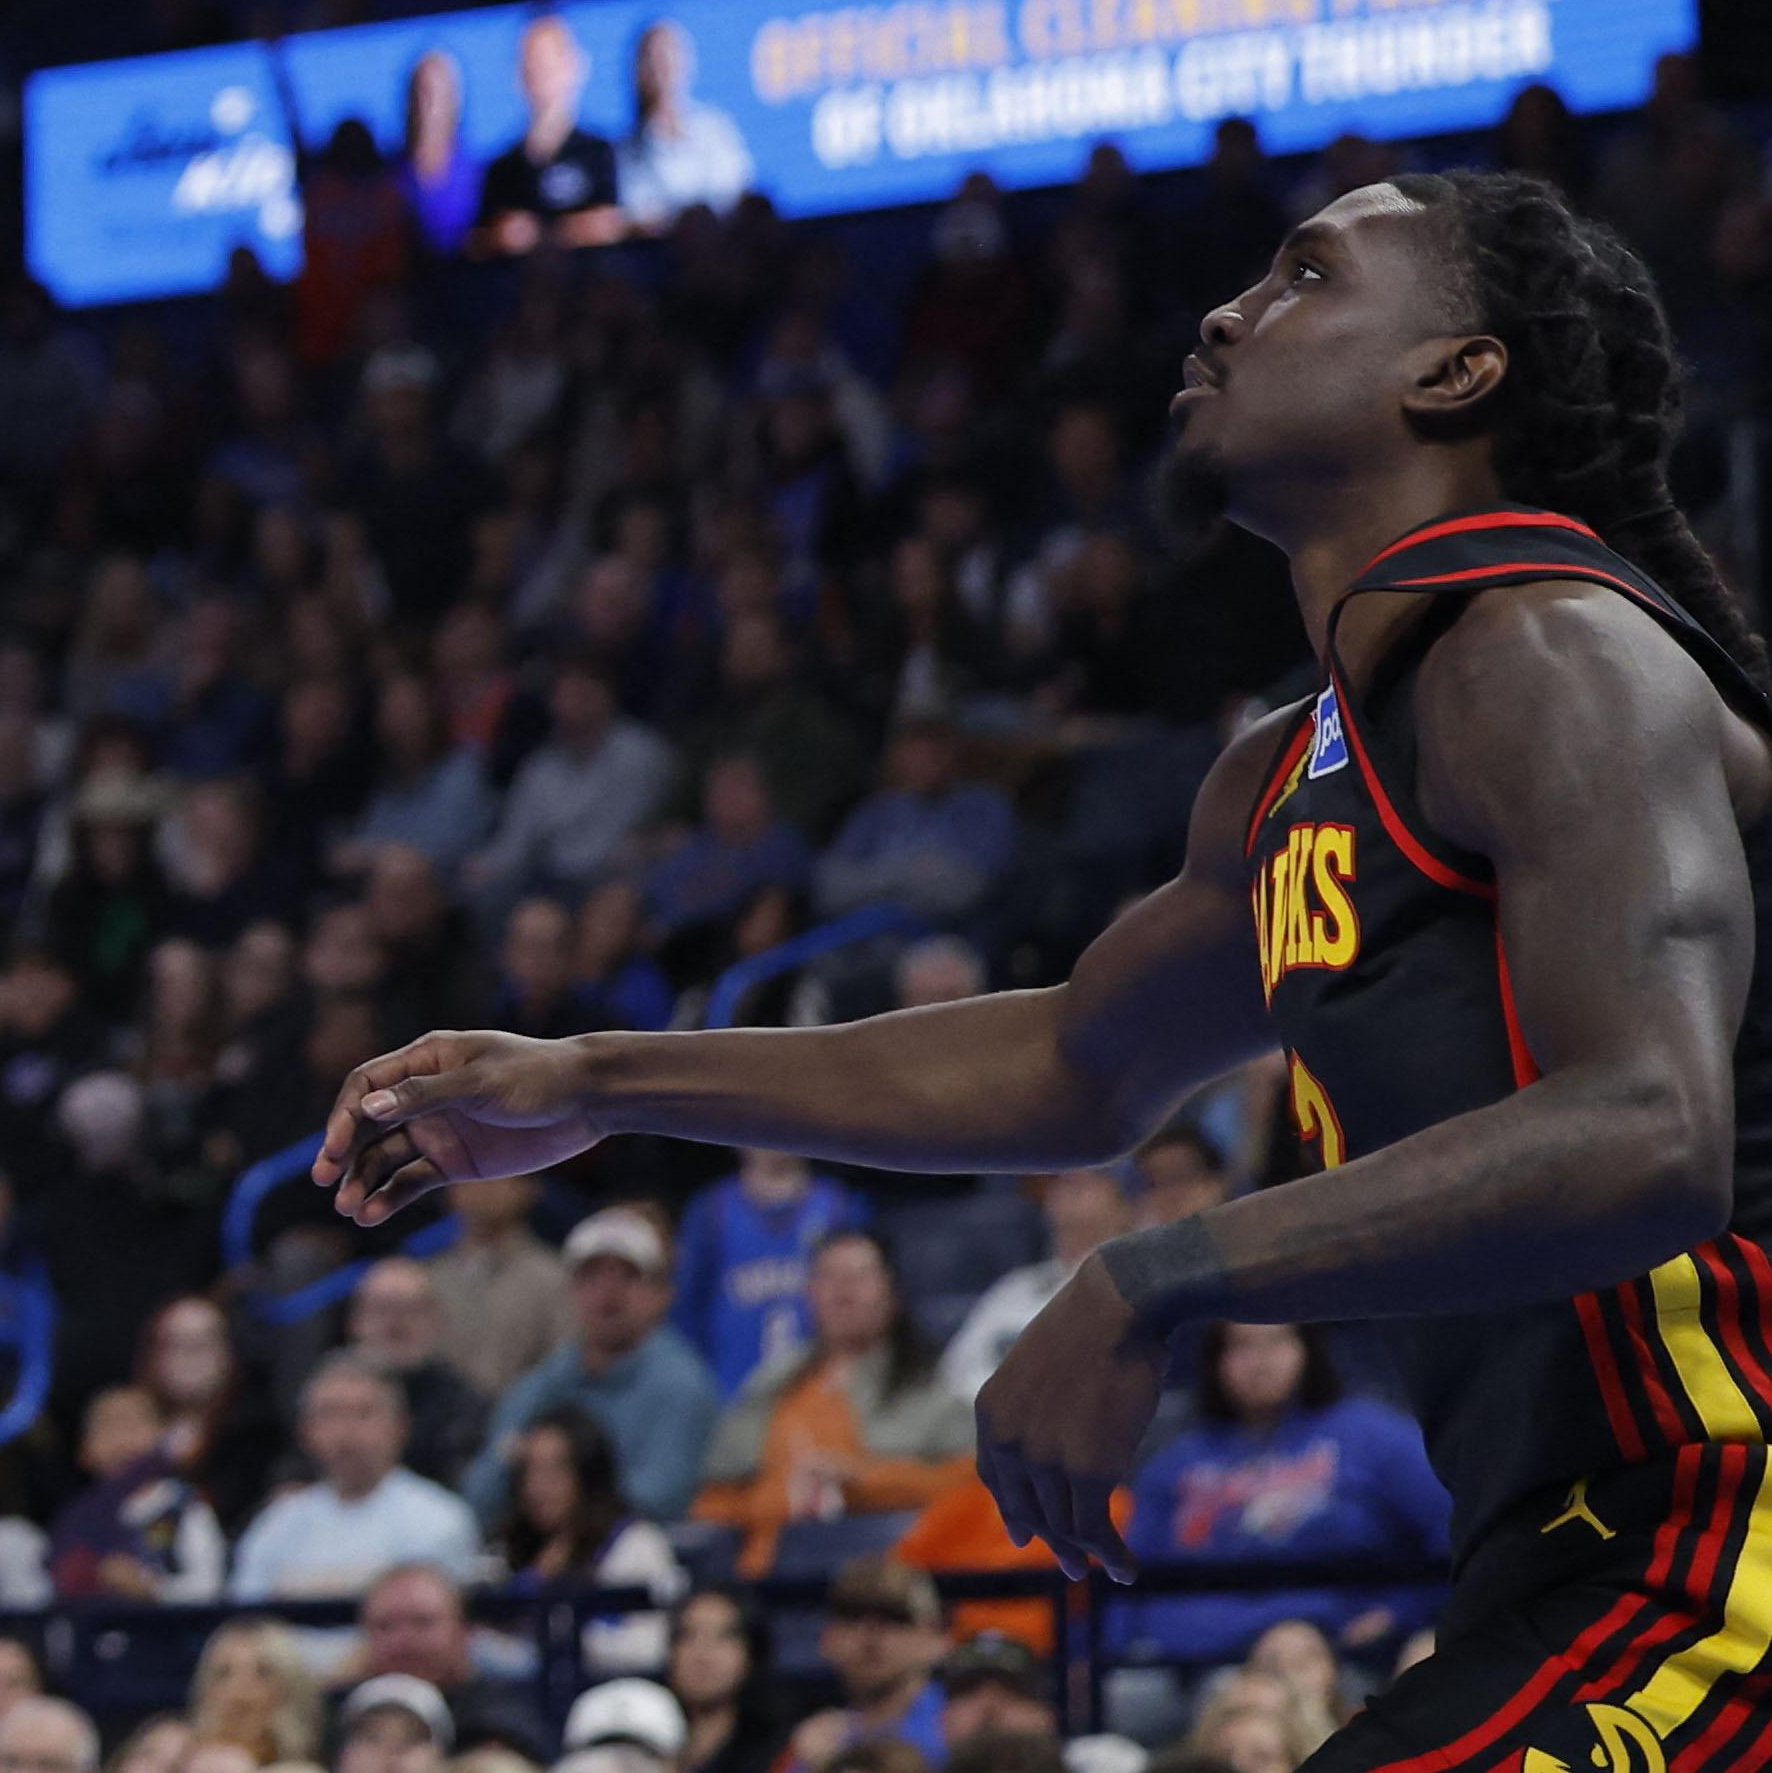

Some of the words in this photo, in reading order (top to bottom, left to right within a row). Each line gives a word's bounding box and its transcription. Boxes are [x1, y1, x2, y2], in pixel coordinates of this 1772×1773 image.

[888, 51, 1169, 154] OKLAHOMA
[1176, 35, 1288, 115] CITY
[1302, 0, 1551, 99] THUNDER
